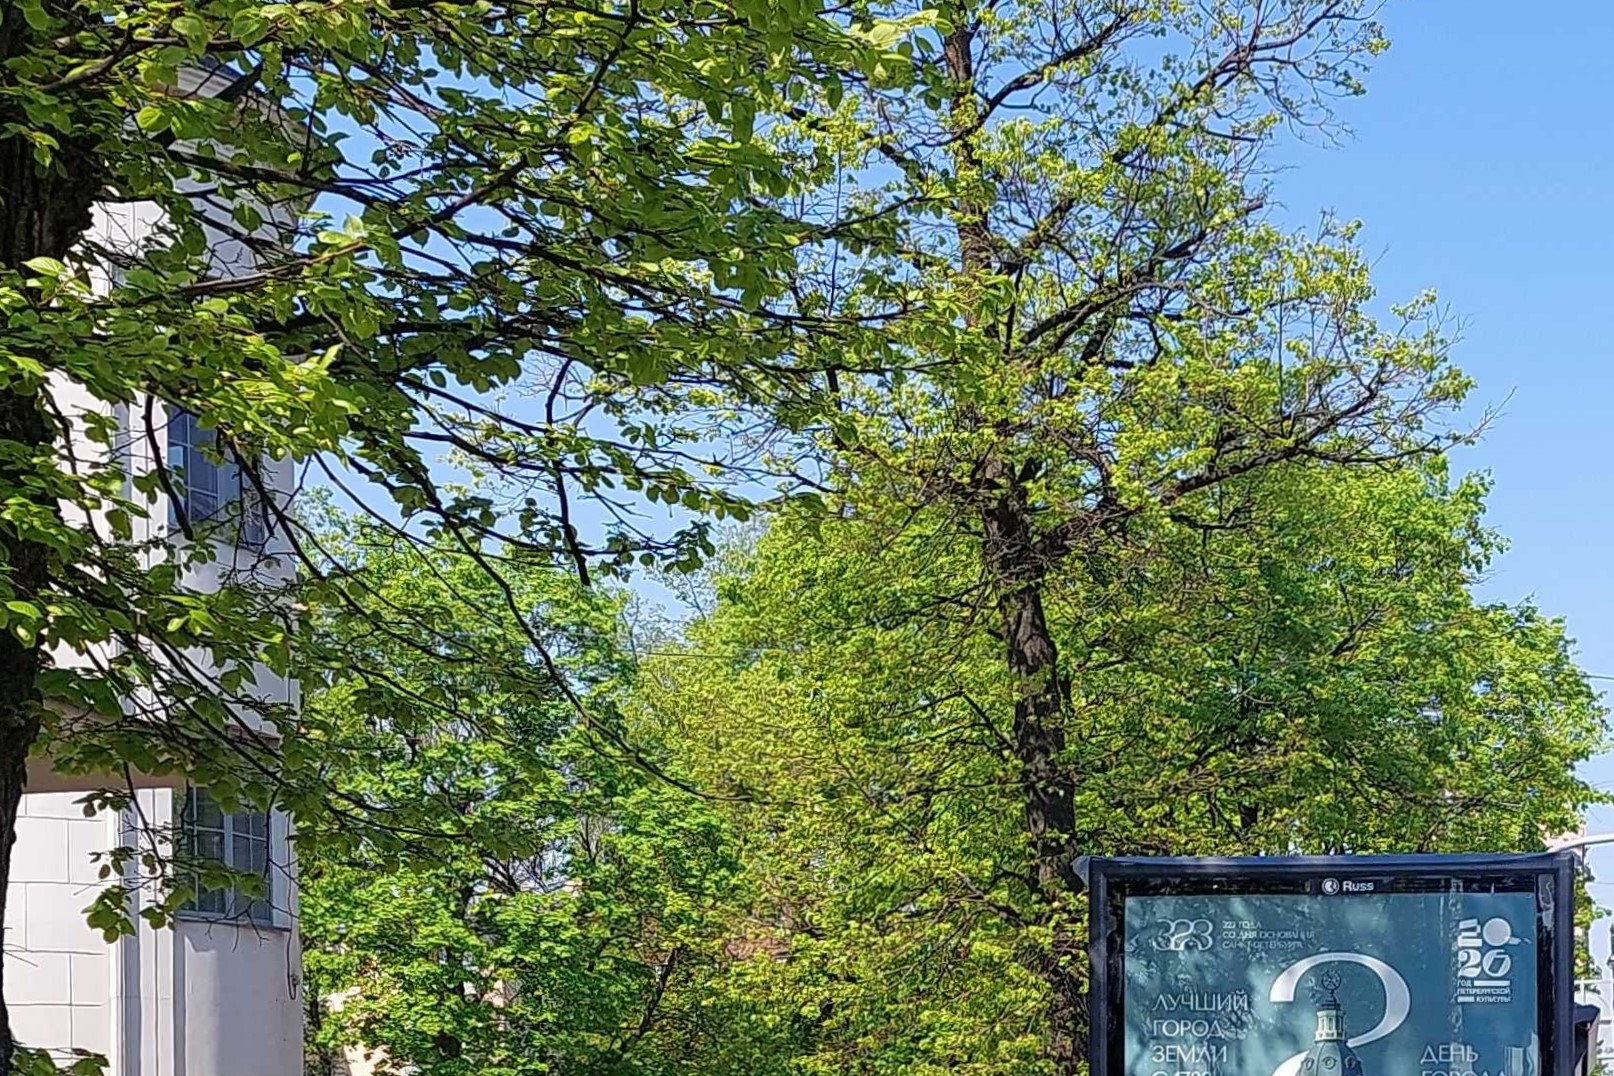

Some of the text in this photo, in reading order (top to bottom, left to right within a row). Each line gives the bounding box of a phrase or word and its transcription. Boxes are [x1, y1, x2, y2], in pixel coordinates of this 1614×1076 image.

[1342, 880, 1374, 891] Russ
[1152, 990, 1248, 1011] ЛУЧШИЙ
[1153, 1019, 1225, 1039] ГОРОД
[1152, 1045, 1227, 1063] ЗЕМЛИ
[1420, 1045, 1478, 1065] ДЕНЬ
